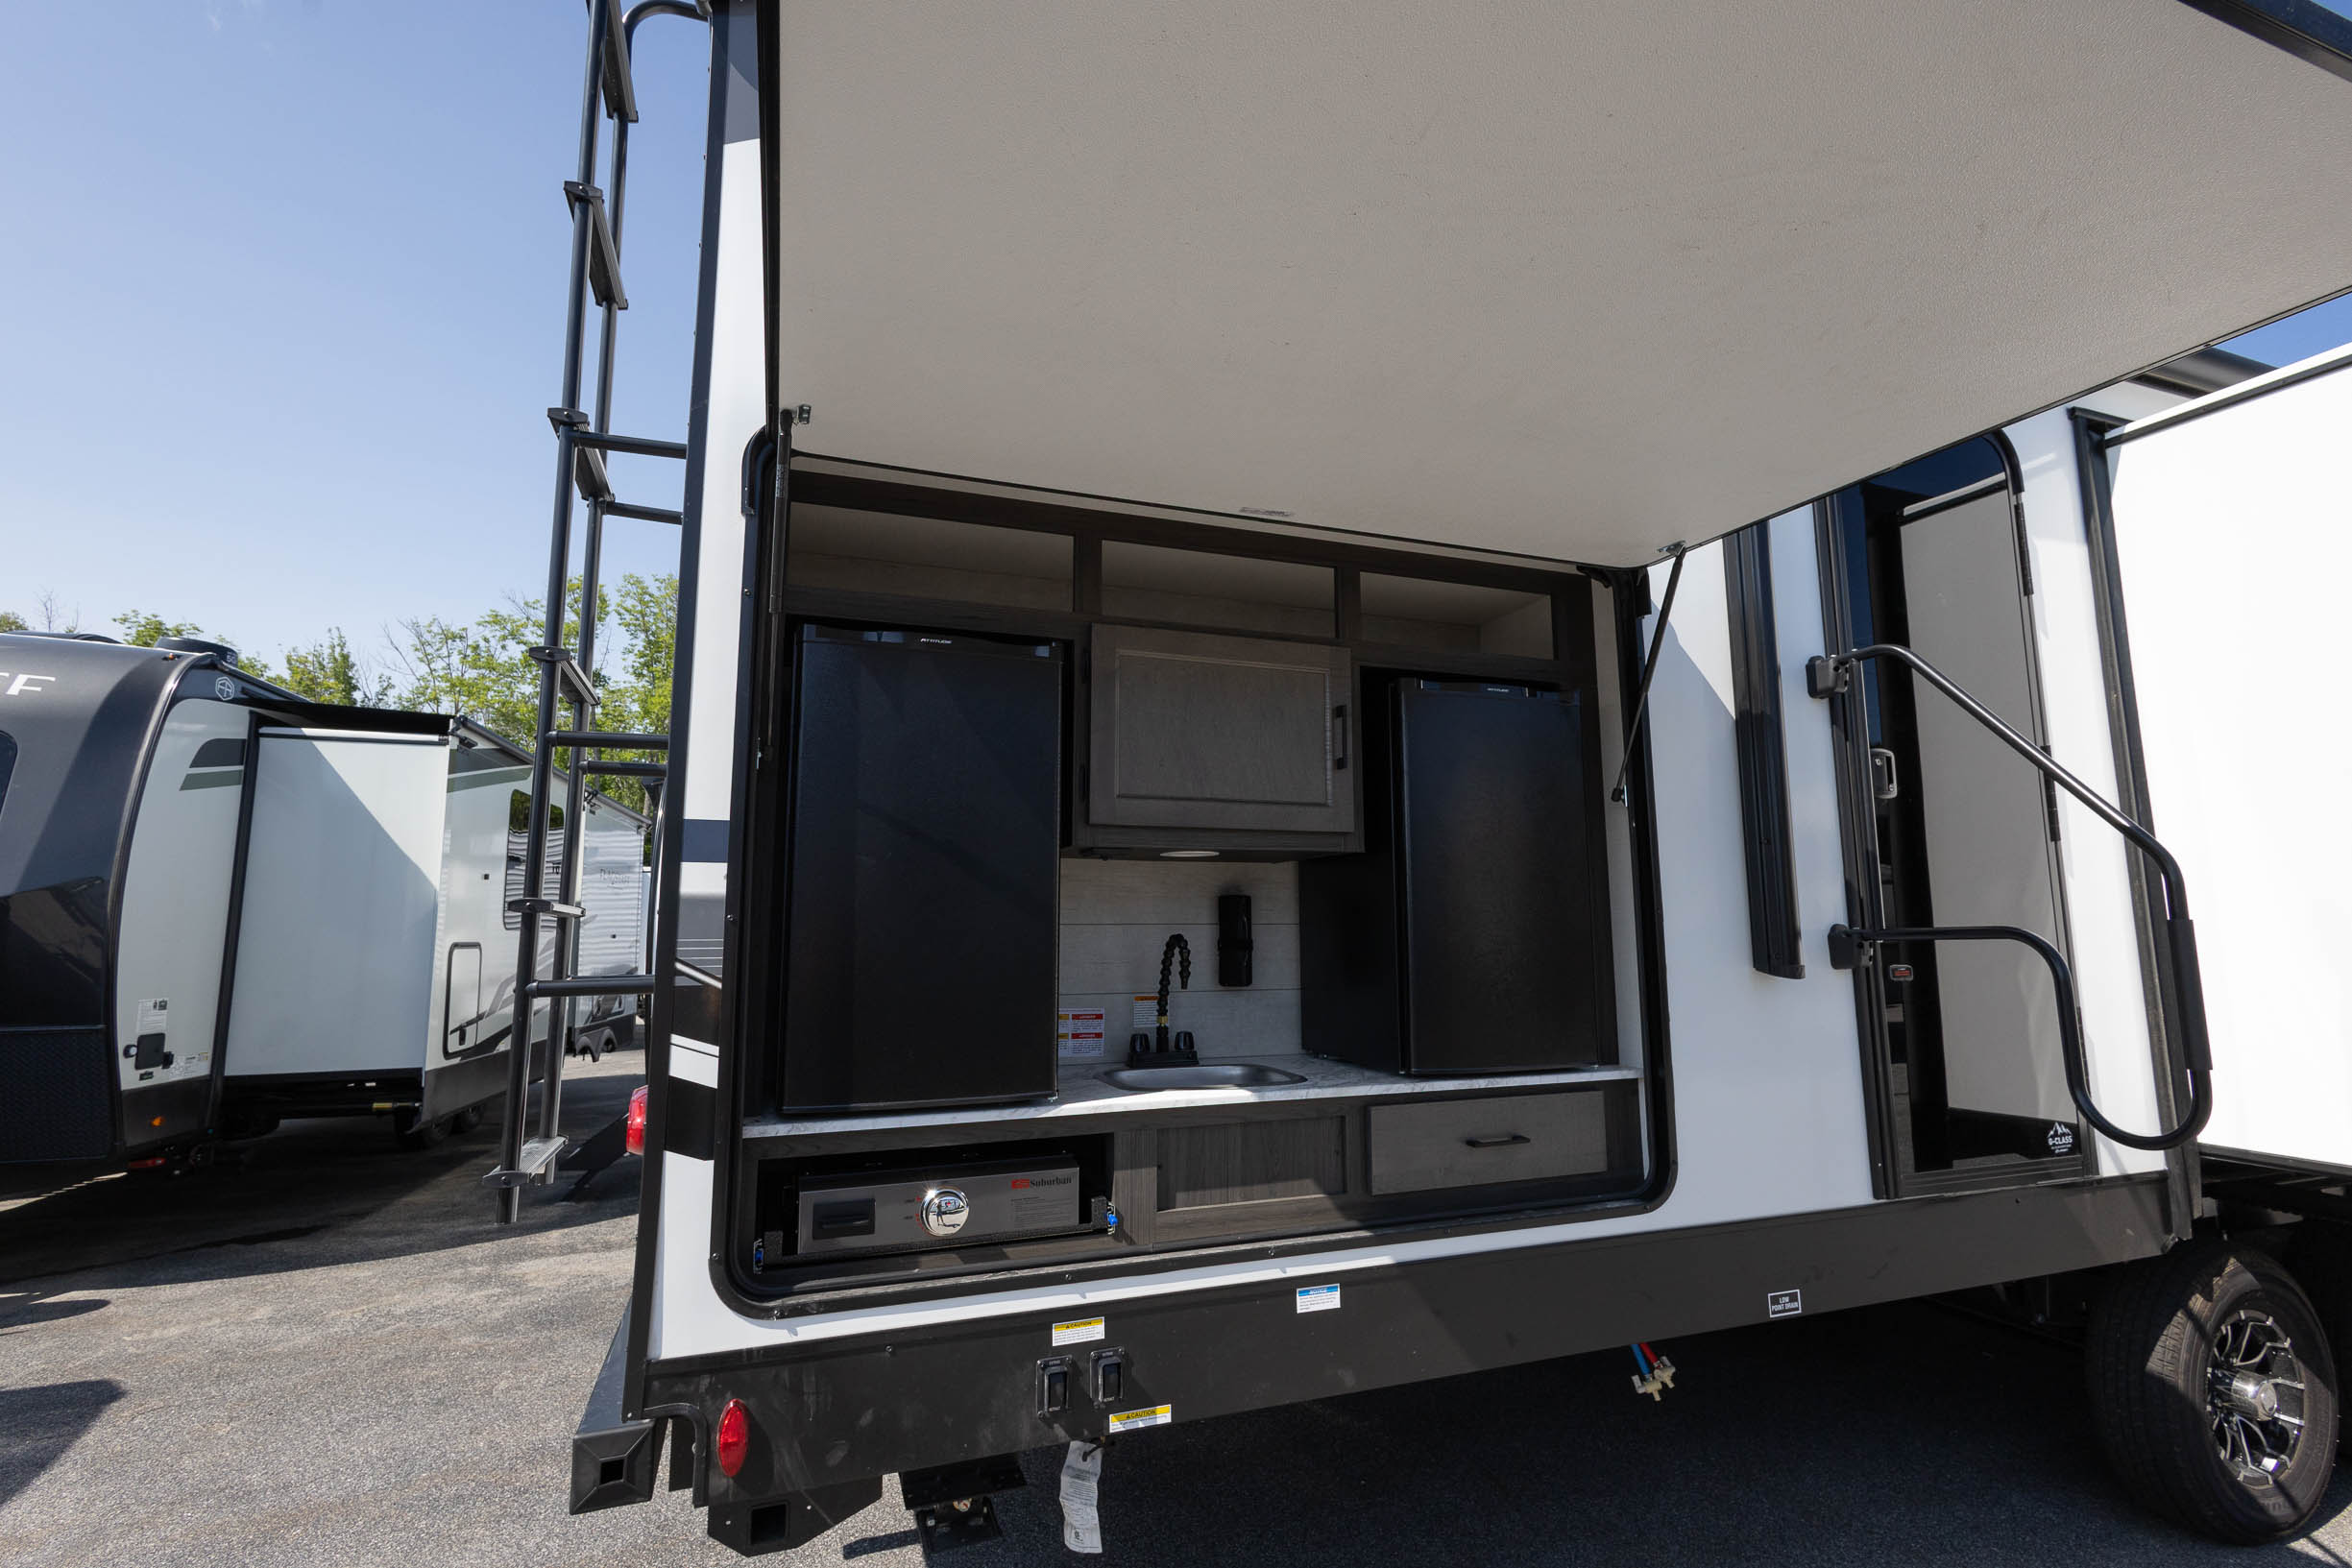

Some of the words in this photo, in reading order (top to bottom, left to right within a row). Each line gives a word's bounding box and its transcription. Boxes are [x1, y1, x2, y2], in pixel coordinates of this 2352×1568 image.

[2048, 1136, 2073, 1145] G-CLASS
[1030, 1175, 1072, 1188] Suburban
[1071, 1320, 1092, 1329] CAUTION
[1130, 1409, 1156, 1418] CAUTION
